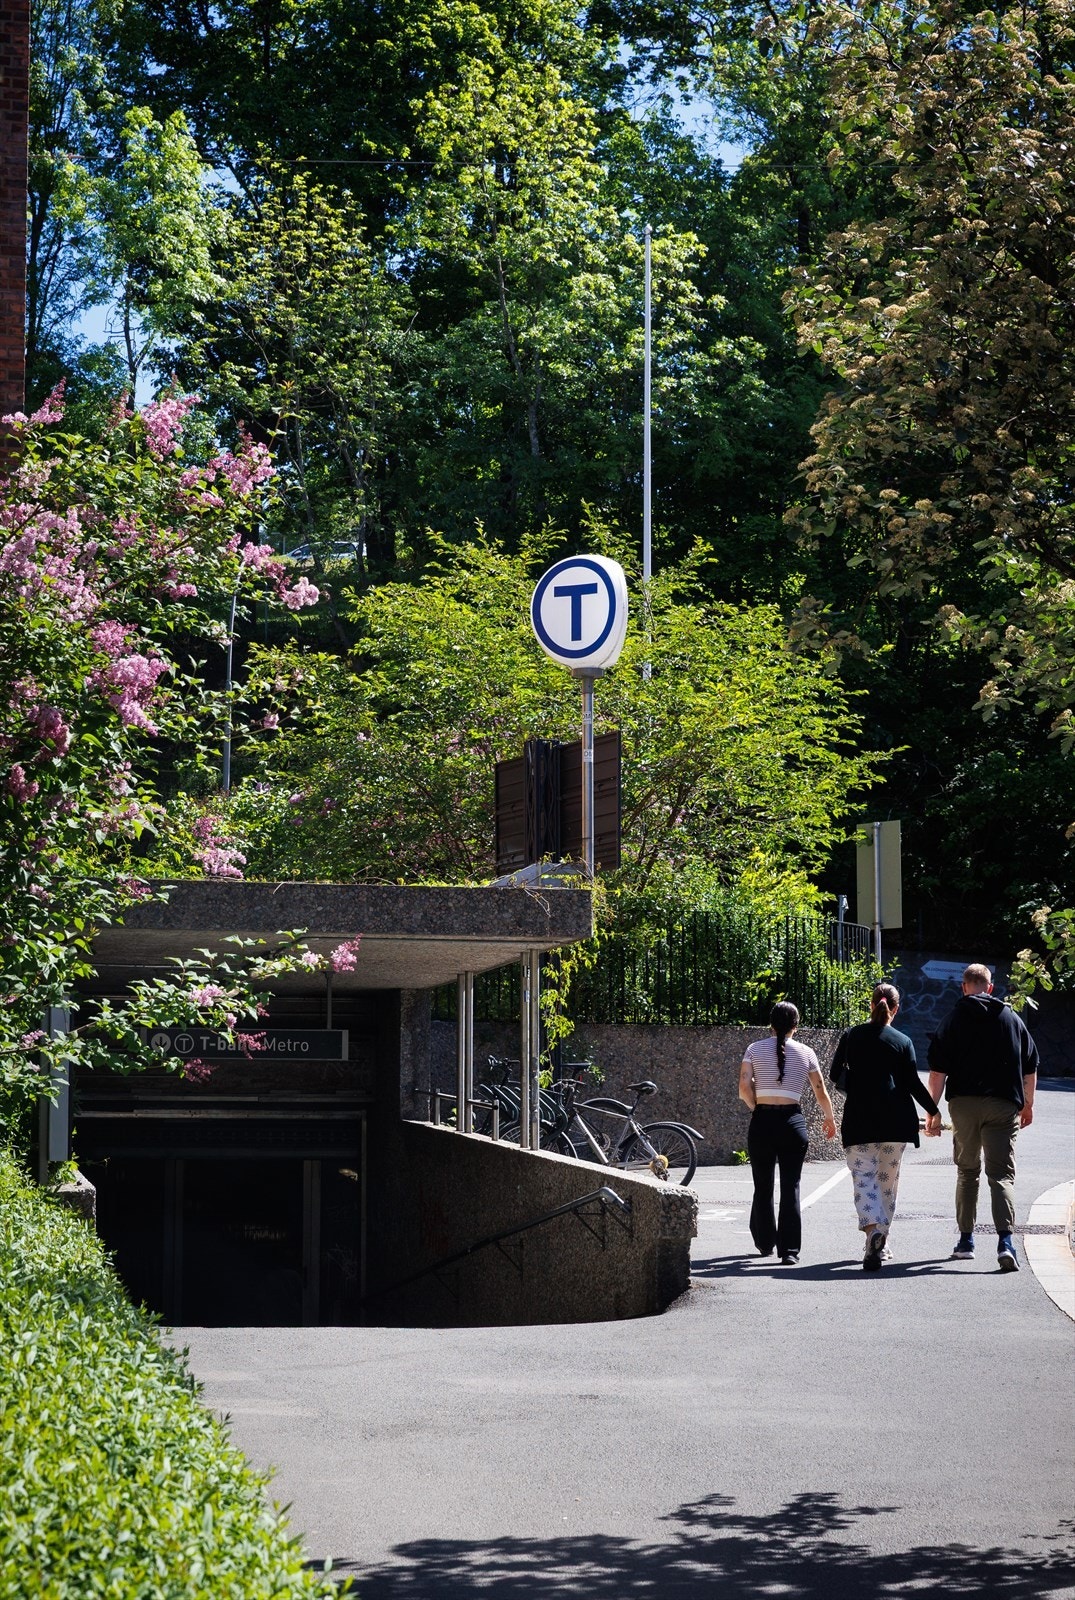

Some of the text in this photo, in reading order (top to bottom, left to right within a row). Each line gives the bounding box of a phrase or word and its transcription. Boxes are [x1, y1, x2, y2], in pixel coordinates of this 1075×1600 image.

[554, 583, 598, 641] T
[177, 1038, 190, 1051] T
[263, 1037, 309, 1052] Metro
